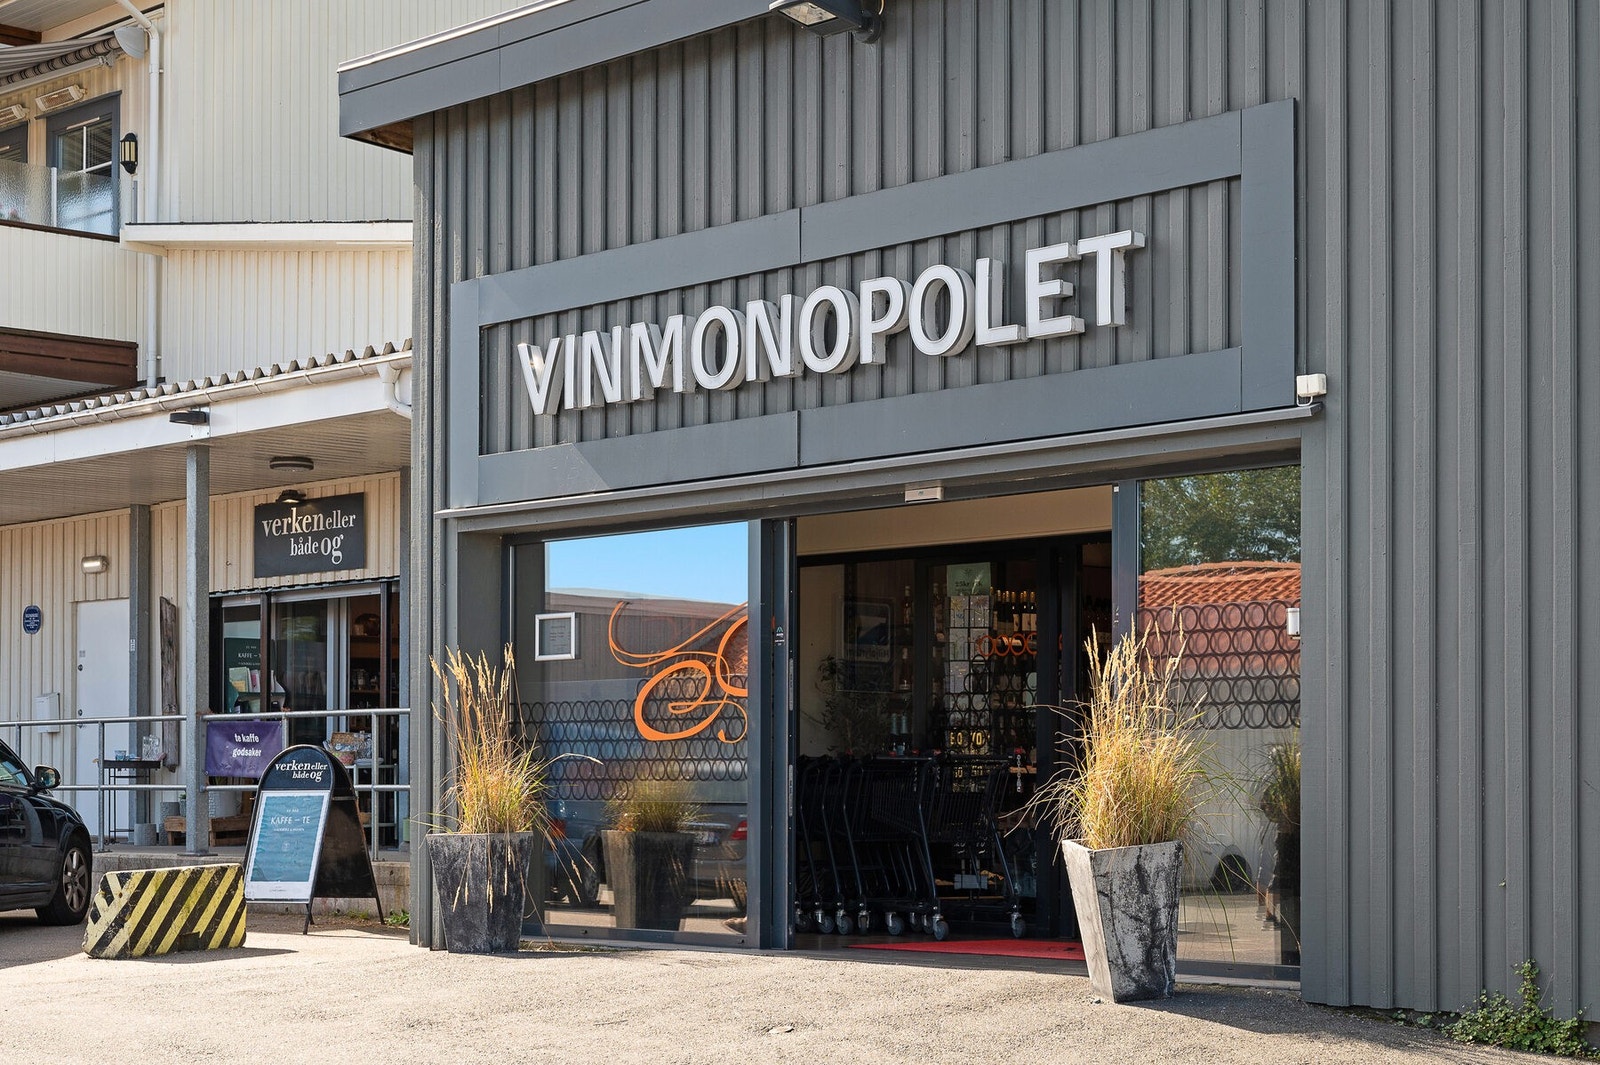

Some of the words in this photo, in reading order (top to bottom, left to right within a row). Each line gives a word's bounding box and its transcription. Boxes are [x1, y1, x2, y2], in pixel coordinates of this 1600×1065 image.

[517, 230, 1145, 415] VINMONOPOLET
[262, 507, 325, 537] verken
[325, 510, 356, 530] eller
[290, 537, 319, 556] både
[320, 534, 344, 565] og
[234, 733, 241, 743] te
[242, 733, 259, 743] kaffe
[232, 747, 262, 758] godsaker
[275, 760, 311, 771] verken
[311, 762, 328, 770] eller
[292, 771, 310, 779] både
[310, 770, 323, 782] og
[270, 815, 293, 825] KAFFE
[302, 816, 311, 824] TE
